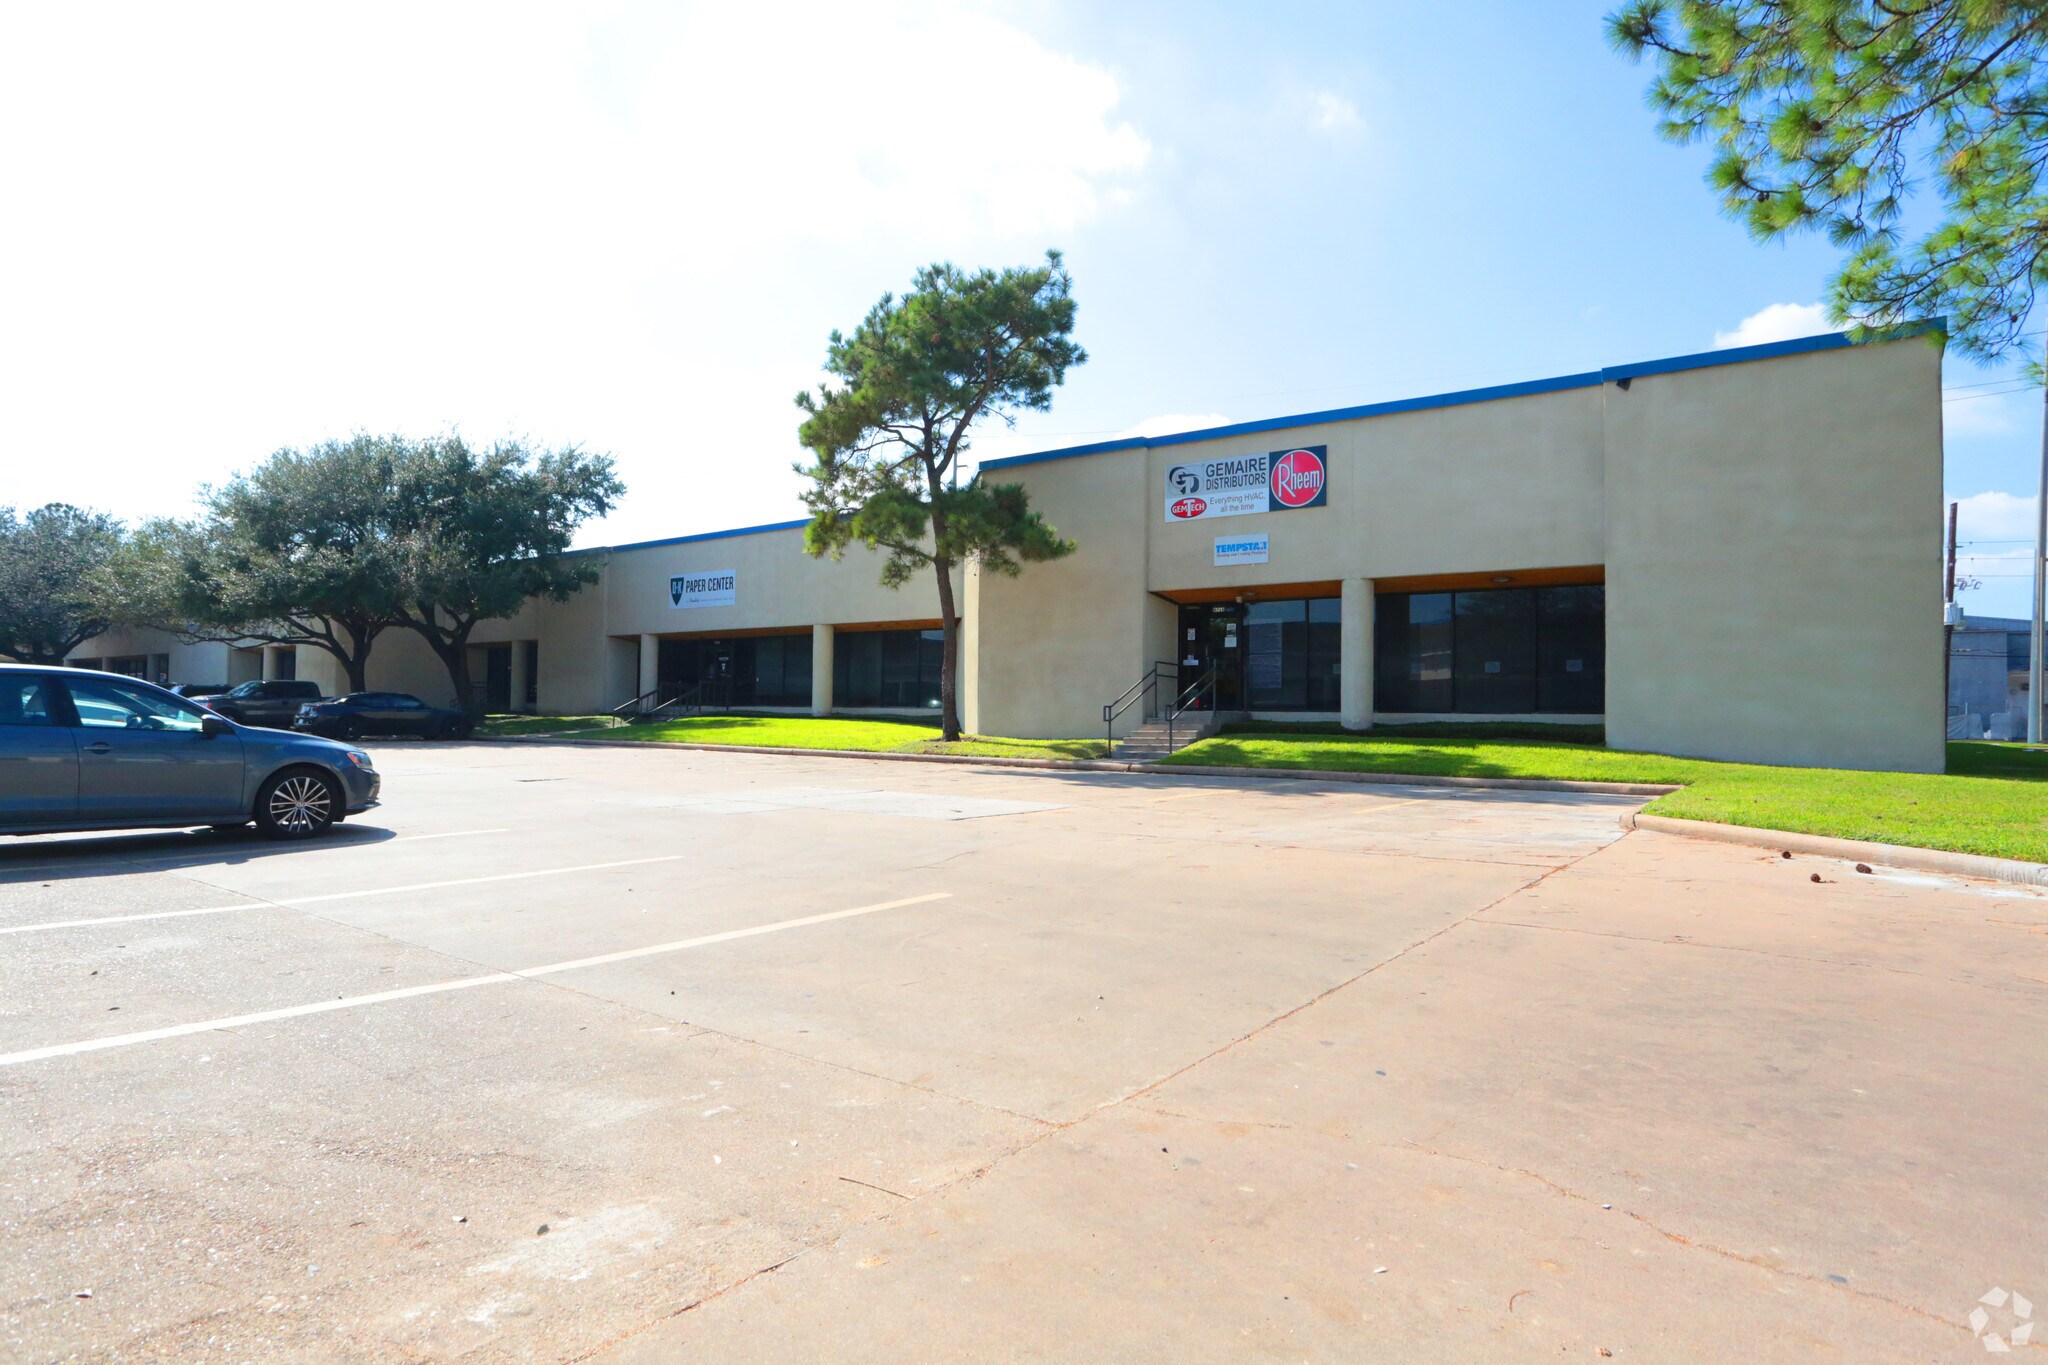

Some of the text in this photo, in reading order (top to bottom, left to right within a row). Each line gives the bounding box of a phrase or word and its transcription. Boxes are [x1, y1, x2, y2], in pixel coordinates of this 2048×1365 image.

[1206, 457, 1267, 477] GEMAIRE
[1206, 473, 1266, 491] DISTRIBUTORS
[1278, 454, 1320, 498] Rheem
[1209, 495, 1243, 505] Everything
[1220, 502, 1254, 513] all the time
[686, 577, 734, 593] PAPER CENTER
